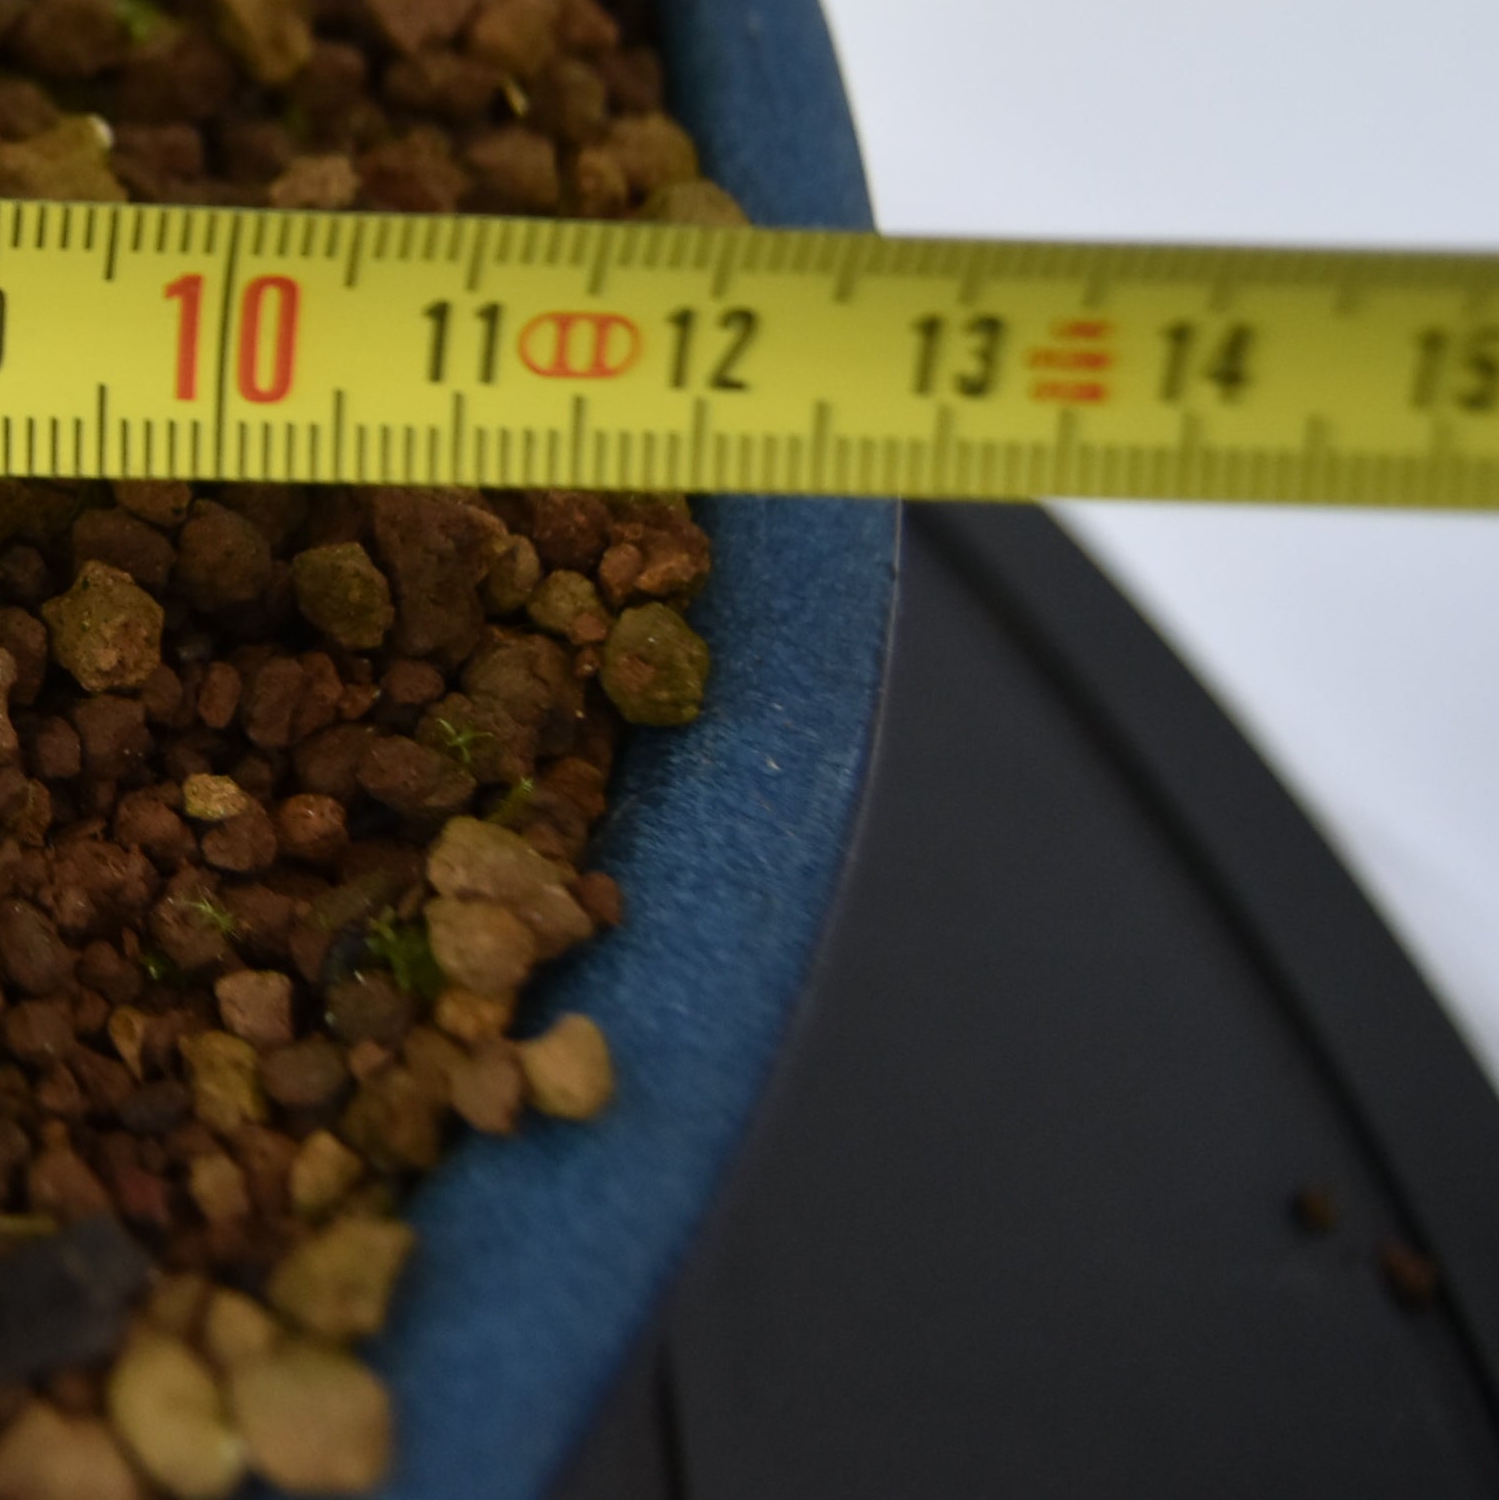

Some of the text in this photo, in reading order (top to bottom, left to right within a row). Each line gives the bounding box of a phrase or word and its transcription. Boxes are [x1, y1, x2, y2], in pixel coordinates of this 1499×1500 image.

[163, 273, 300, 403] 10
[423, 300, 506, 384] 11
[667, 307, 760, 391] 12
[911, 314, 1003, 397] 13
[1159, 323, 1253, 404] 14
